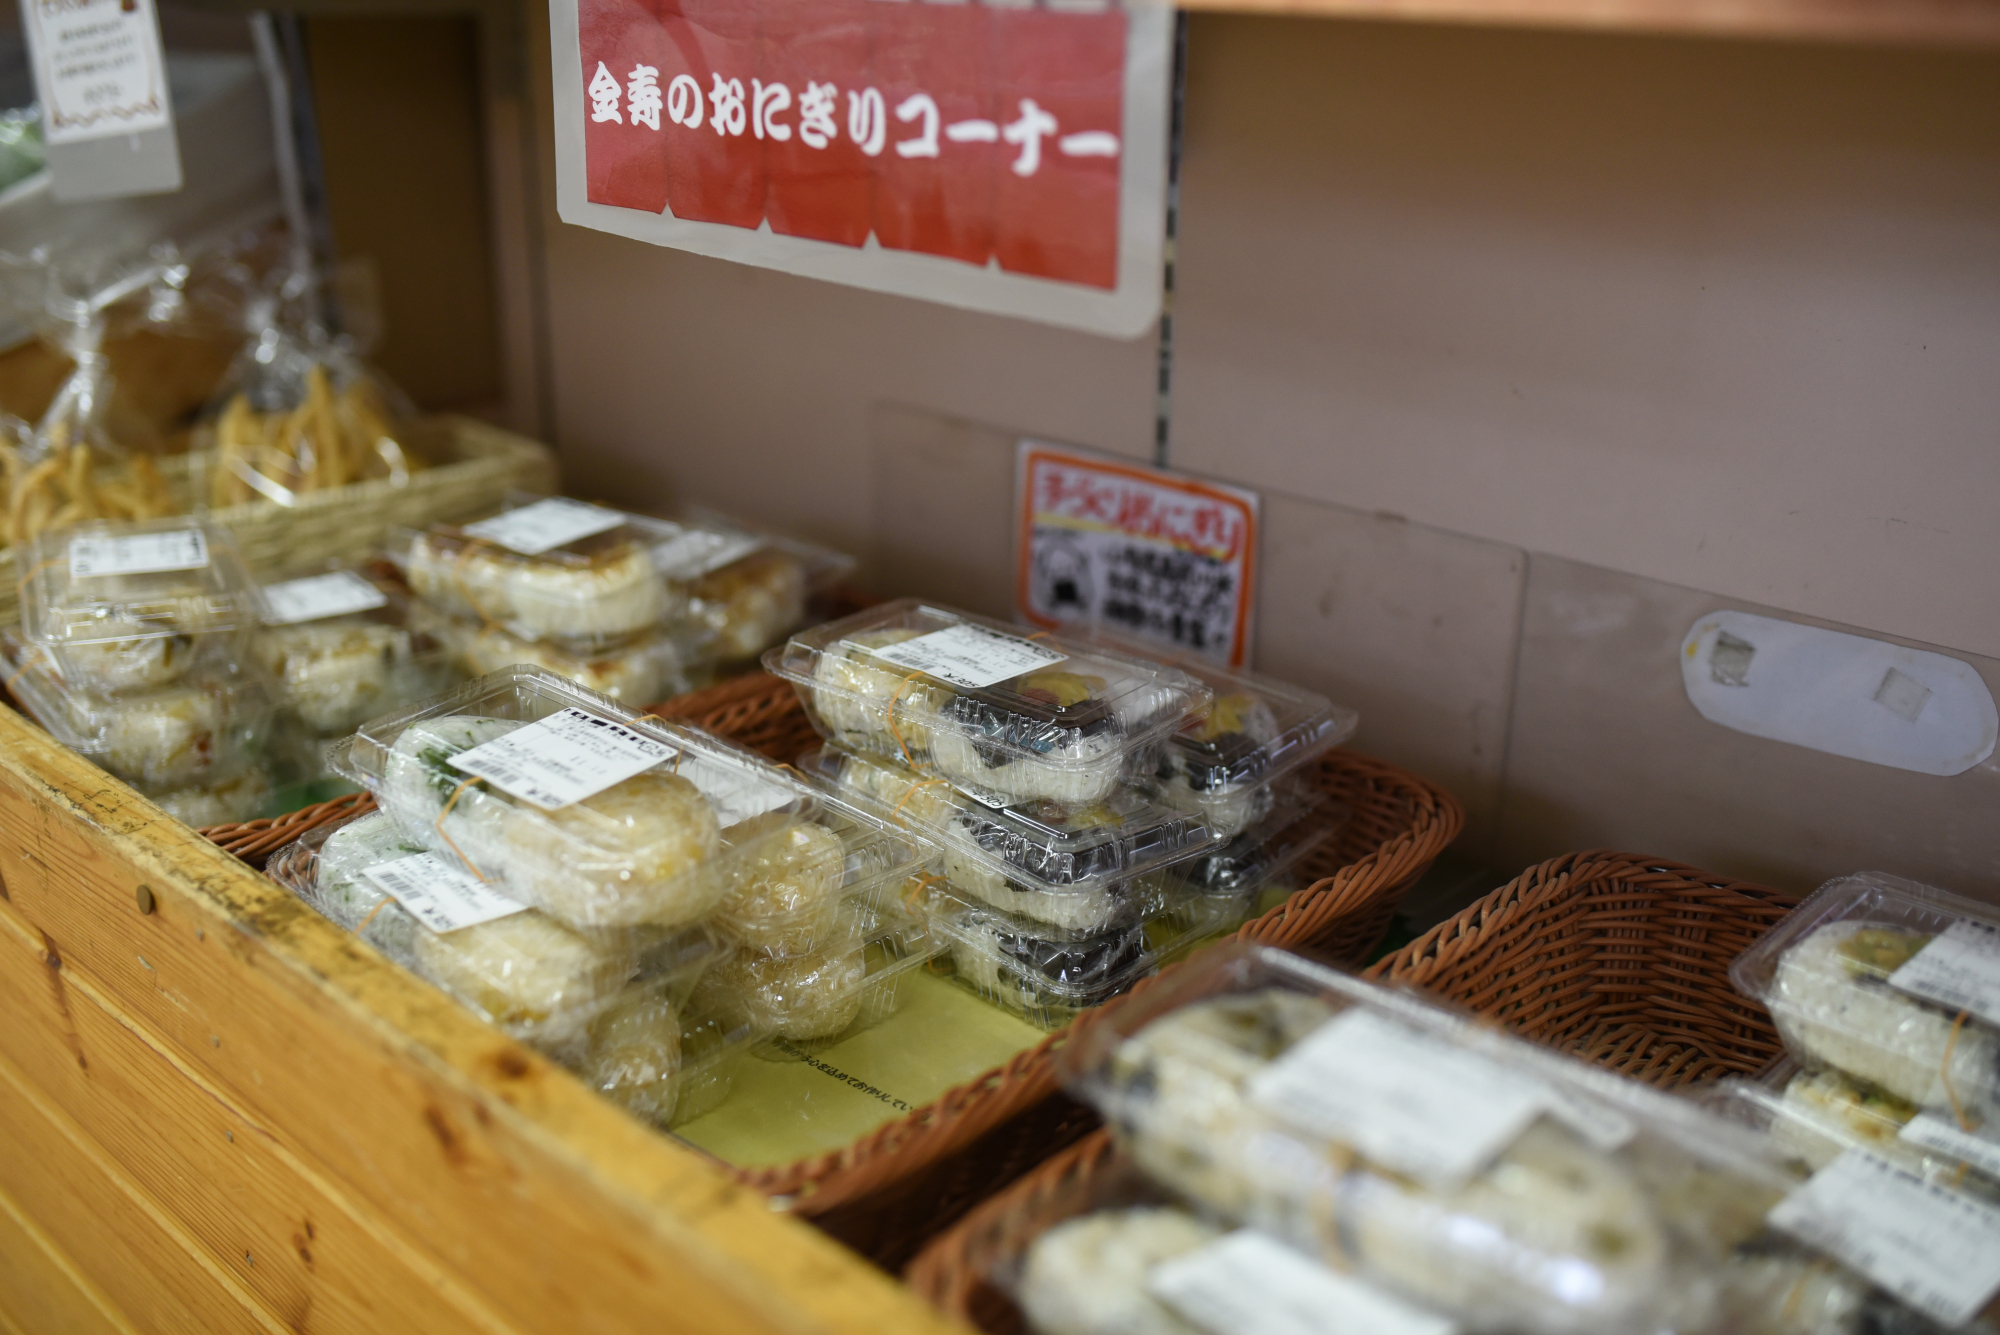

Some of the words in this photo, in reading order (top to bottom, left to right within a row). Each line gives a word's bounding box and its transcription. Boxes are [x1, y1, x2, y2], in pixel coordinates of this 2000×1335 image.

[587, 60, 1120, 178] 金寿のおにぎりコーナー
[773, 1036, 914, 1112] から心を込めてお作りしてい
